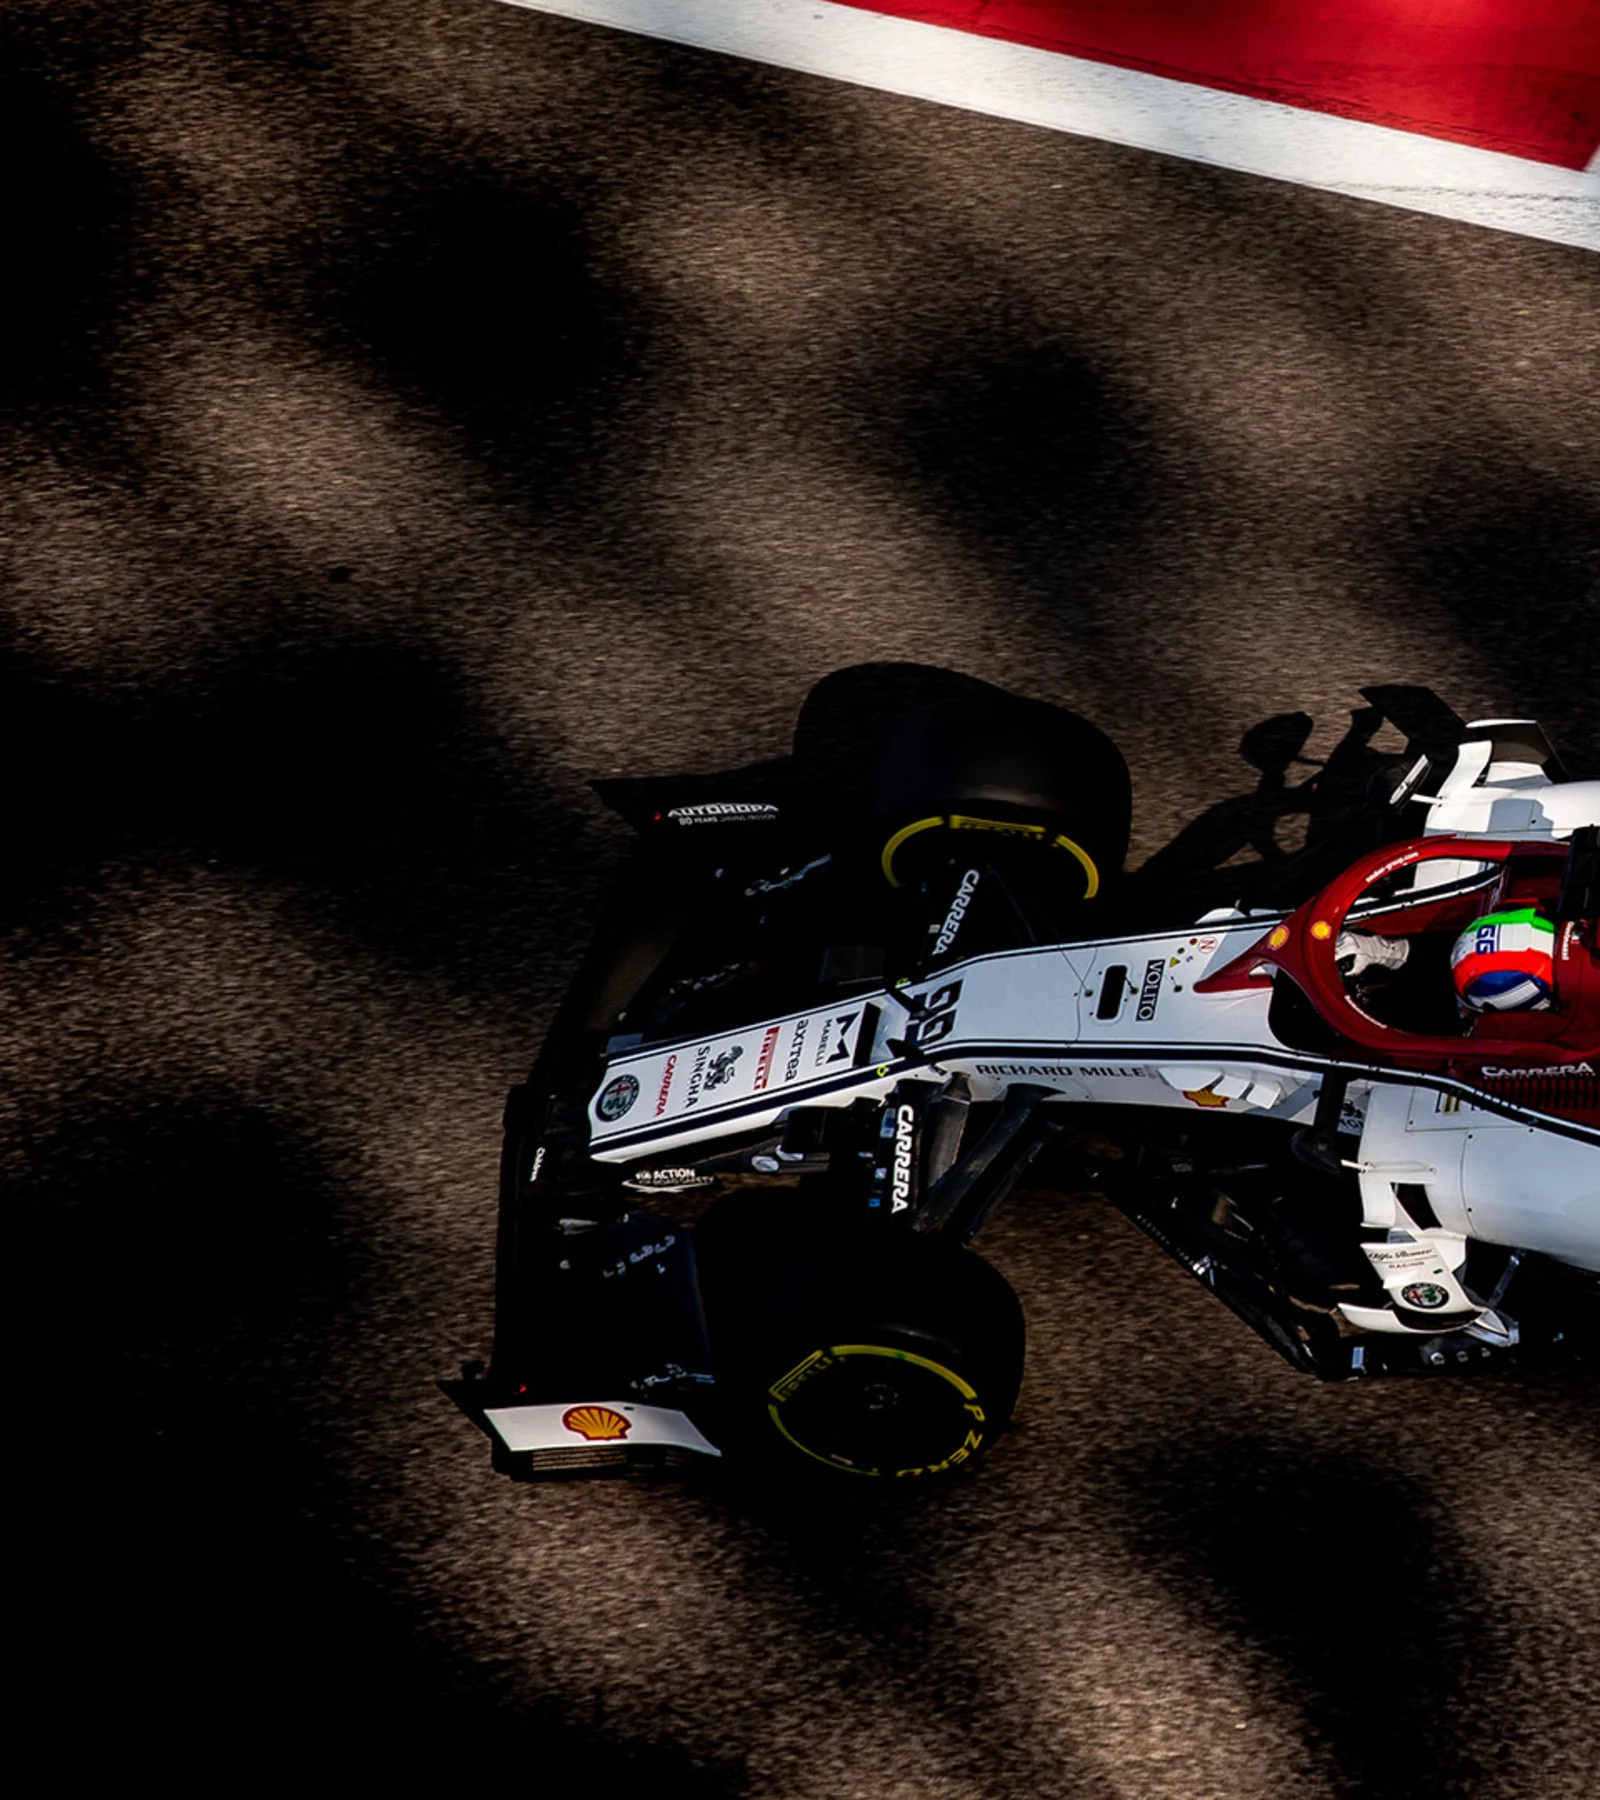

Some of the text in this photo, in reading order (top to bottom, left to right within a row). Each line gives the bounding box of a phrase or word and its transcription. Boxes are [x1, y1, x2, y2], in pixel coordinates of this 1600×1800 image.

[930, 868, 981, 956] CARRERA
[1140, 961, 1164, 1020] VOLITO
[815, 1018, 833, 1067] MARELLI
[976, 1064, 1145, 1078] RICHARD MILLE
[1481, 1061, 1594, 1076] CARRERA
[655, 1054, 678, 1117] CARRERA
[685, 1045, 710, 1108] SINGHA
[653, 1168, 695, 1180] ACTION
[891, 1104, 915, 1214] CARRERA
